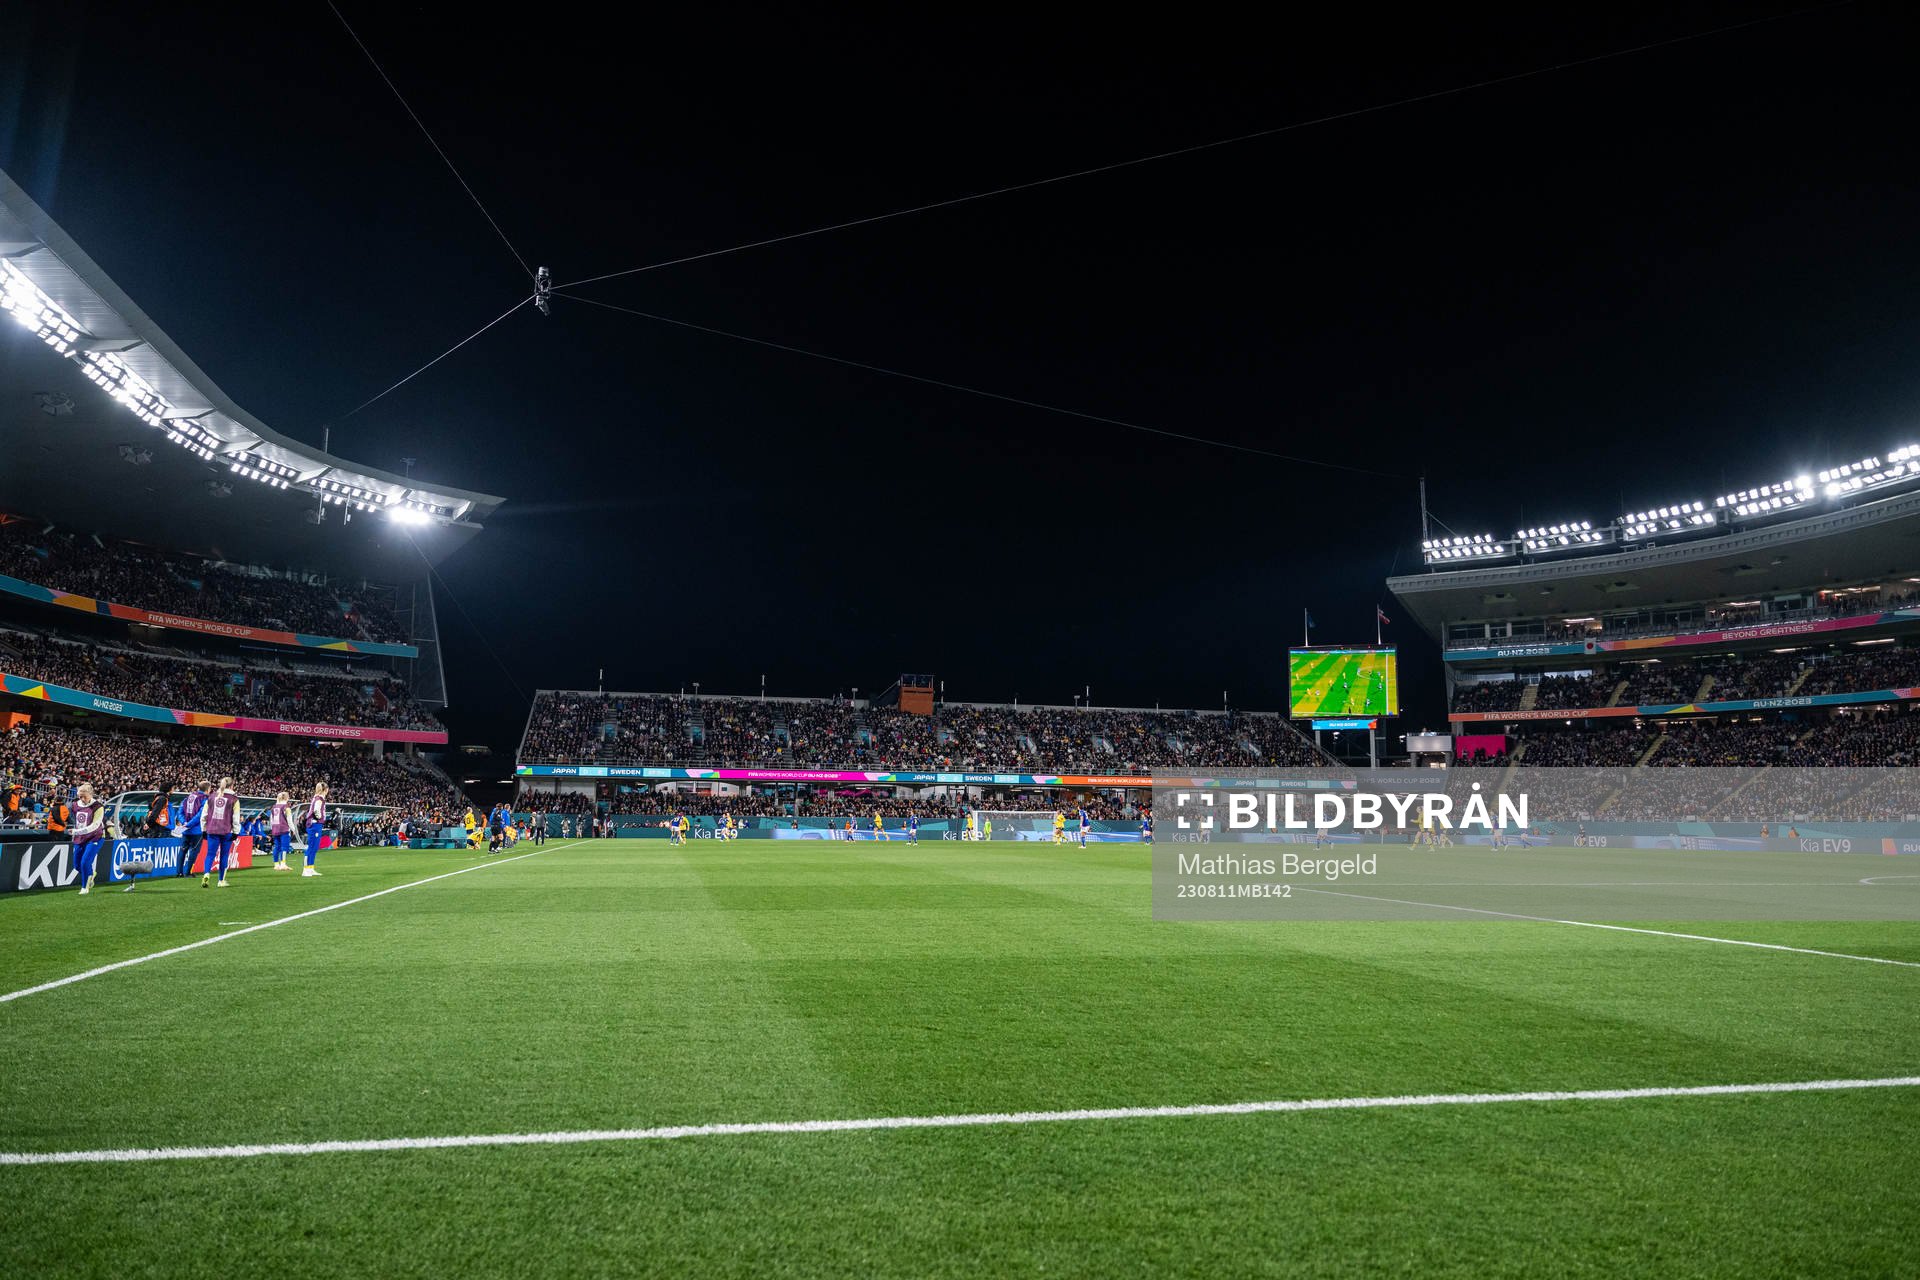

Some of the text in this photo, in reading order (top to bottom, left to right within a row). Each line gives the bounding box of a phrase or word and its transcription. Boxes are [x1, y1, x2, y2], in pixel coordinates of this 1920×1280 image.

[148, 614, 252, 636] FIFA WOMEN'S WORLD CUP
[1722, 624, 1814, 640] BEYOND GREATNESS
[1483, 712, 1500, 720] FIFA
[1501, 711, 1539, 719] WOMEN'S
[280, 724, 361, 736] BEYOND GREATNESS
[694, 828, 738, 839] Kia E9
[1172, 832, 1187, 842] Kia
[1588, 835, 1607, 847] EV9
[1800, 838, 1851, 853] Kia EV9
